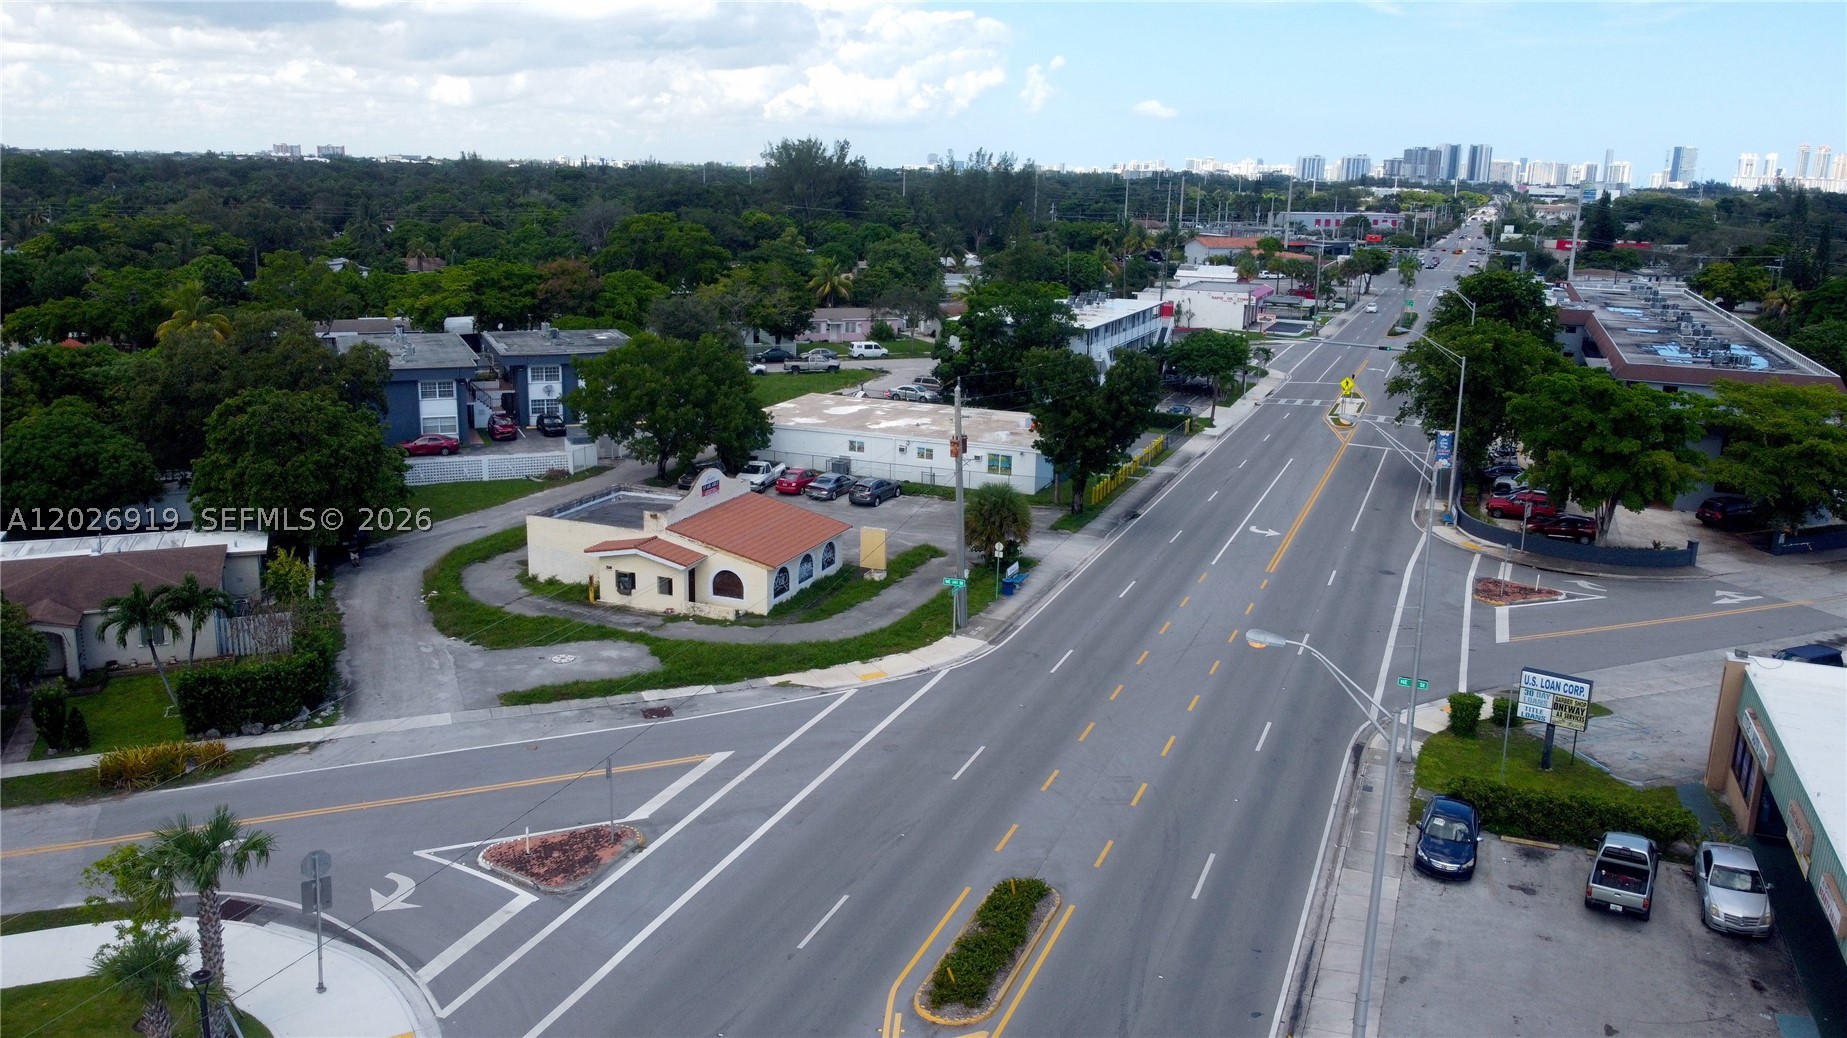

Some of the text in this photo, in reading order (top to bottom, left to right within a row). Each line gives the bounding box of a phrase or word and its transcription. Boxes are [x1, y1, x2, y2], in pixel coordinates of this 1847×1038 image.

[1524, 674, 1585, 697] U.S. LOAN CORP.
[1536, 690, 1550, 699] DAY
[1523, 695, 1548, 707] LOANS
[1555, 696, 1587, 708] BARBER SHOP
[1524, 705, 1544, 715] TITLE
[1553, 702, 1586, 716] ONEWAY
[1520, 711, 1546, 722] LOANS
